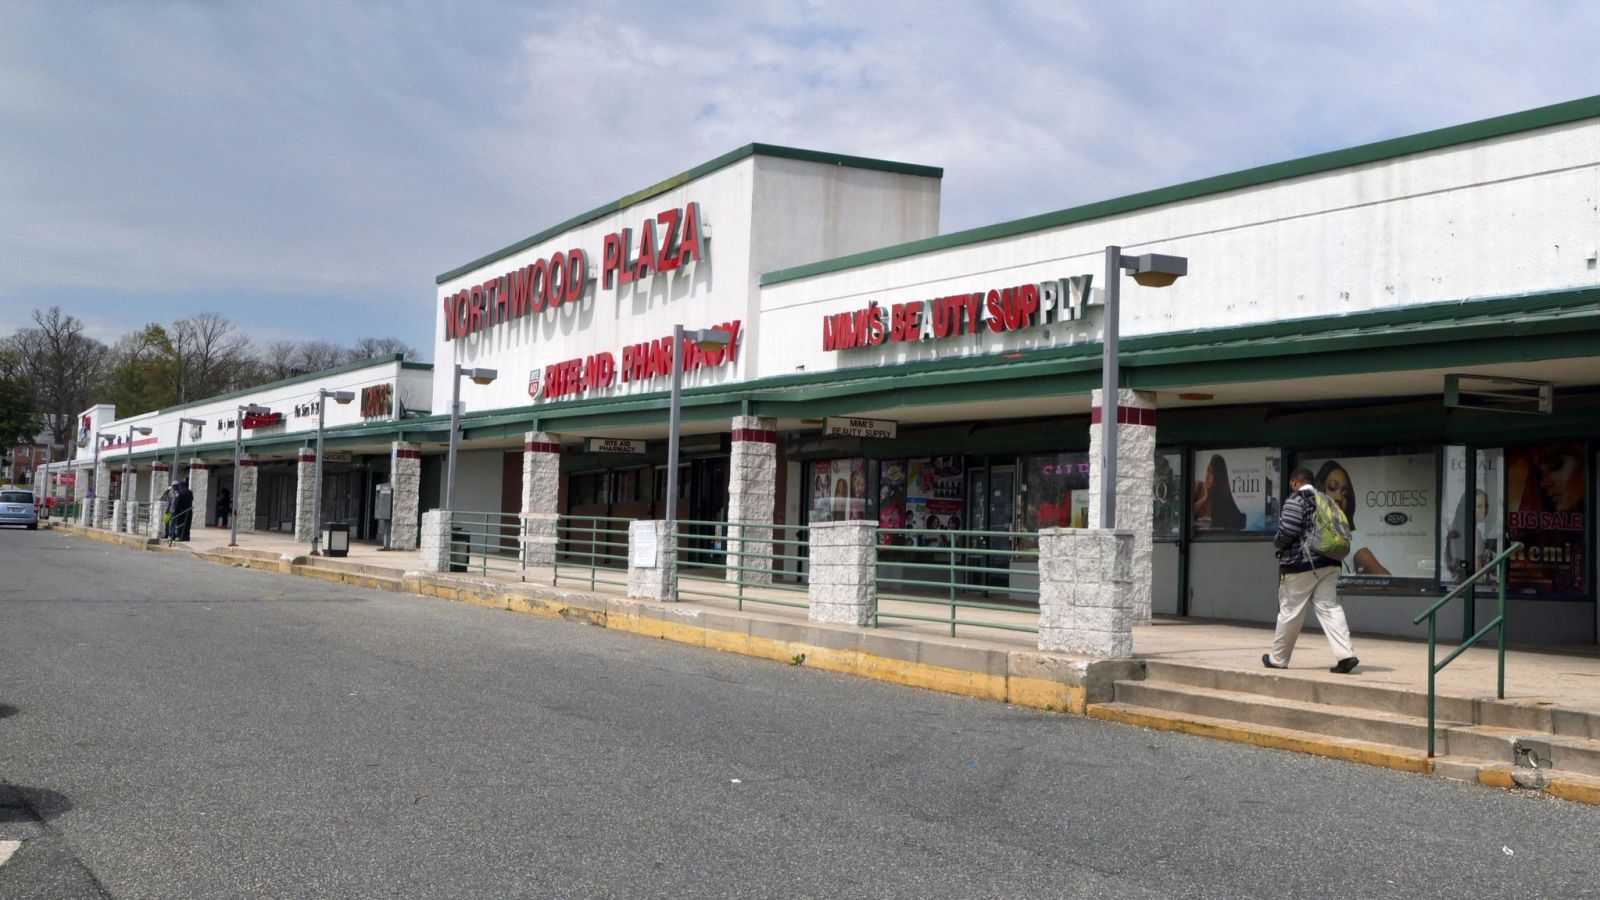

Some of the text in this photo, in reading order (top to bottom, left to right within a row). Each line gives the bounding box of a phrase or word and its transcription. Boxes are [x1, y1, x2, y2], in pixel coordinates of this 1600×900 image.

[444, 202, 705, 341] NORTHWOOD PLAZA
[822, 274, 1093, 352] MIMI'S BEAUTY SUPPLY
[544, 358, 583, 399] RITE
[580, 351, 615, 391] AID
[831, 426, 892, 438] BEAUTY SUPPLY
[1232, 474, 1260, 493] rain
[1365, 490, 1428, 507] GODDESS
[1386, 513, 1406, 525] REMI
[1509, 511, 1584, 531] BIG SALE
